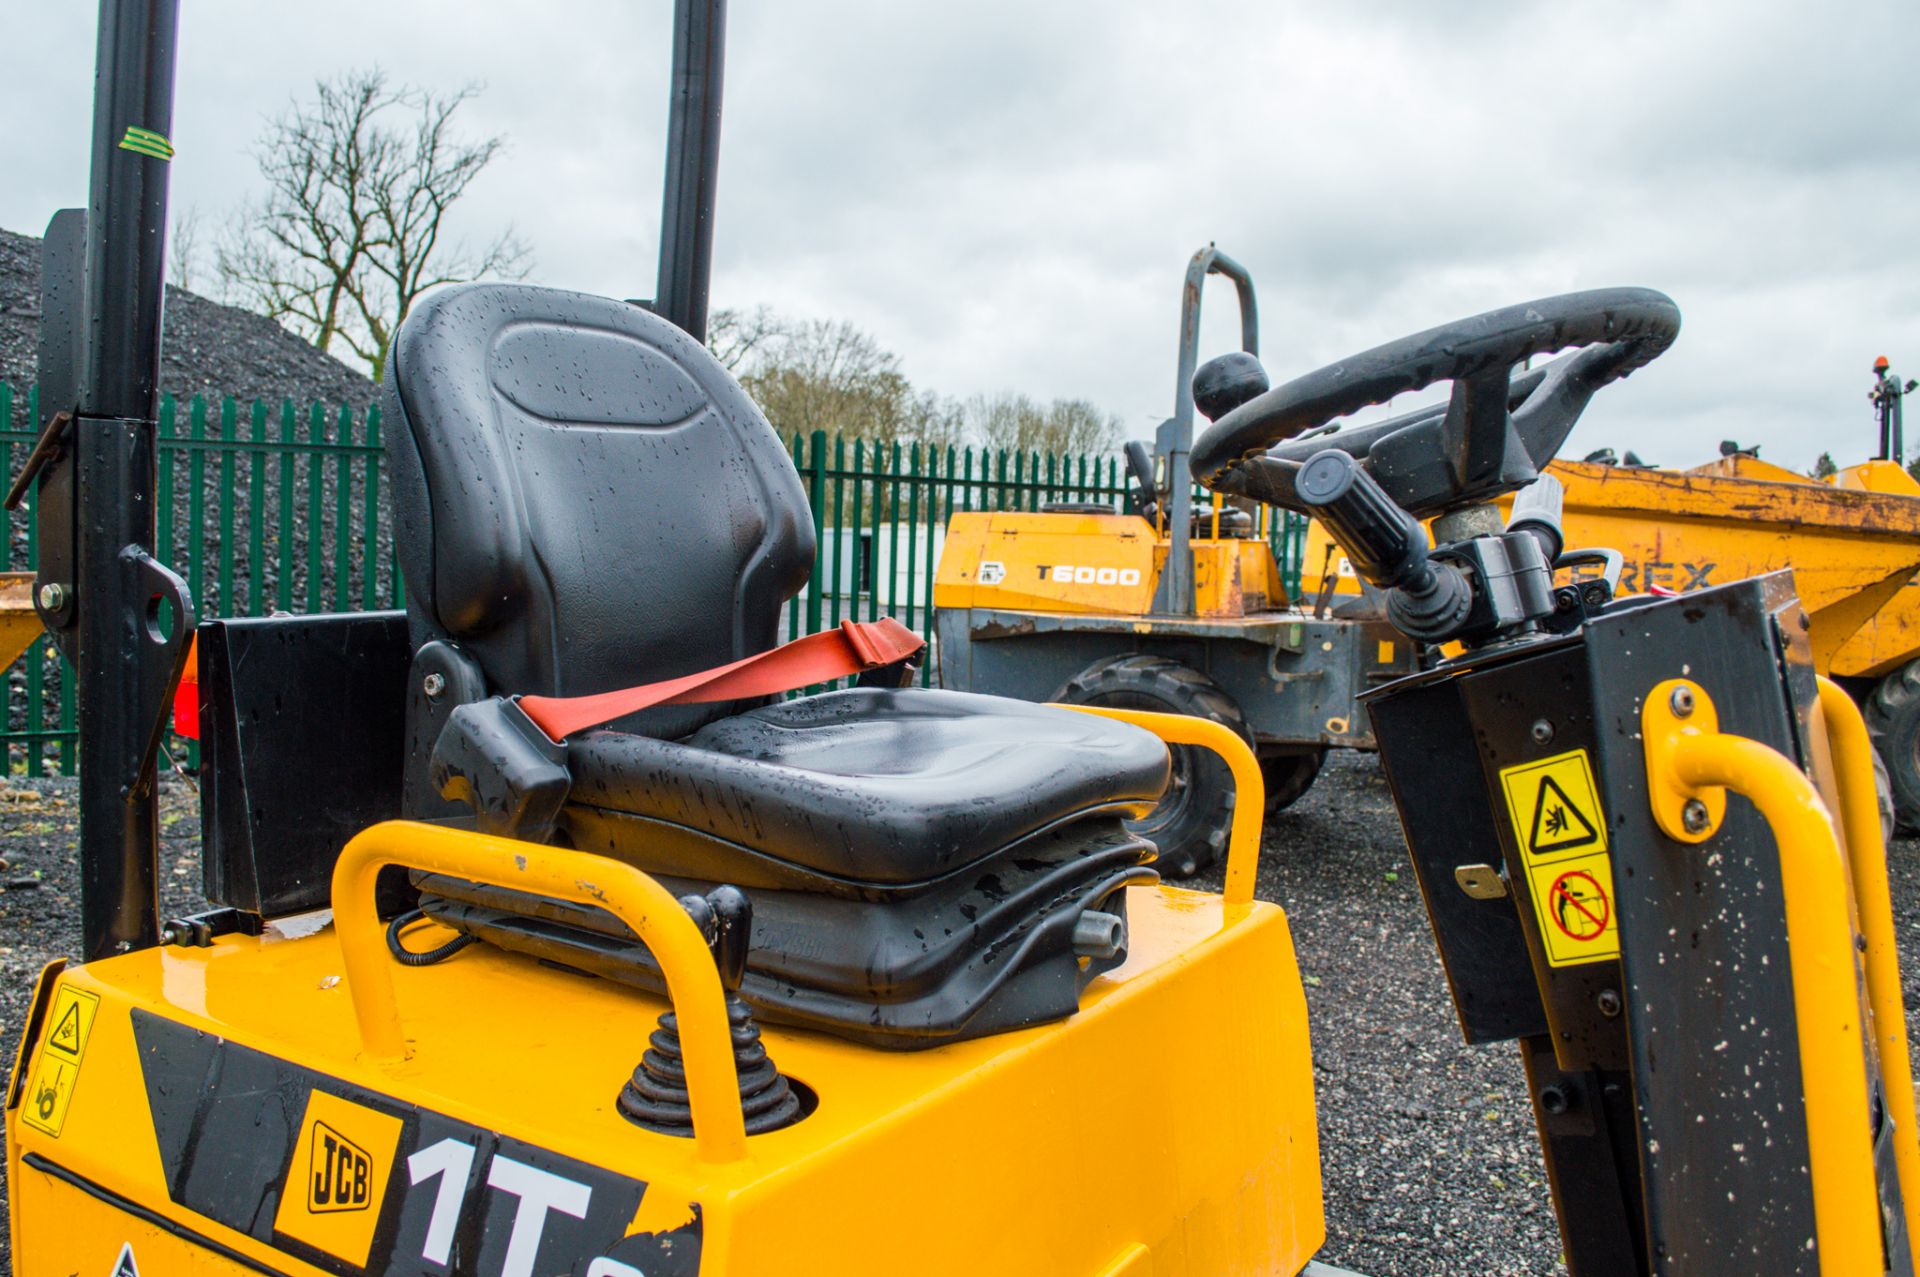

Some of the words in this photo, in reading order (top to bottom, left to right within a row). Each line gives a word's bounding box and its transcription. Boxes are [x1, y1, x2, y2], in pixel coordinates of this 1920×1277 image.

[1036, 565, 1141, 586] T6000
[315, 1134, 367, 1205] JCB
[408, 1137, 644, 1277] 1T
